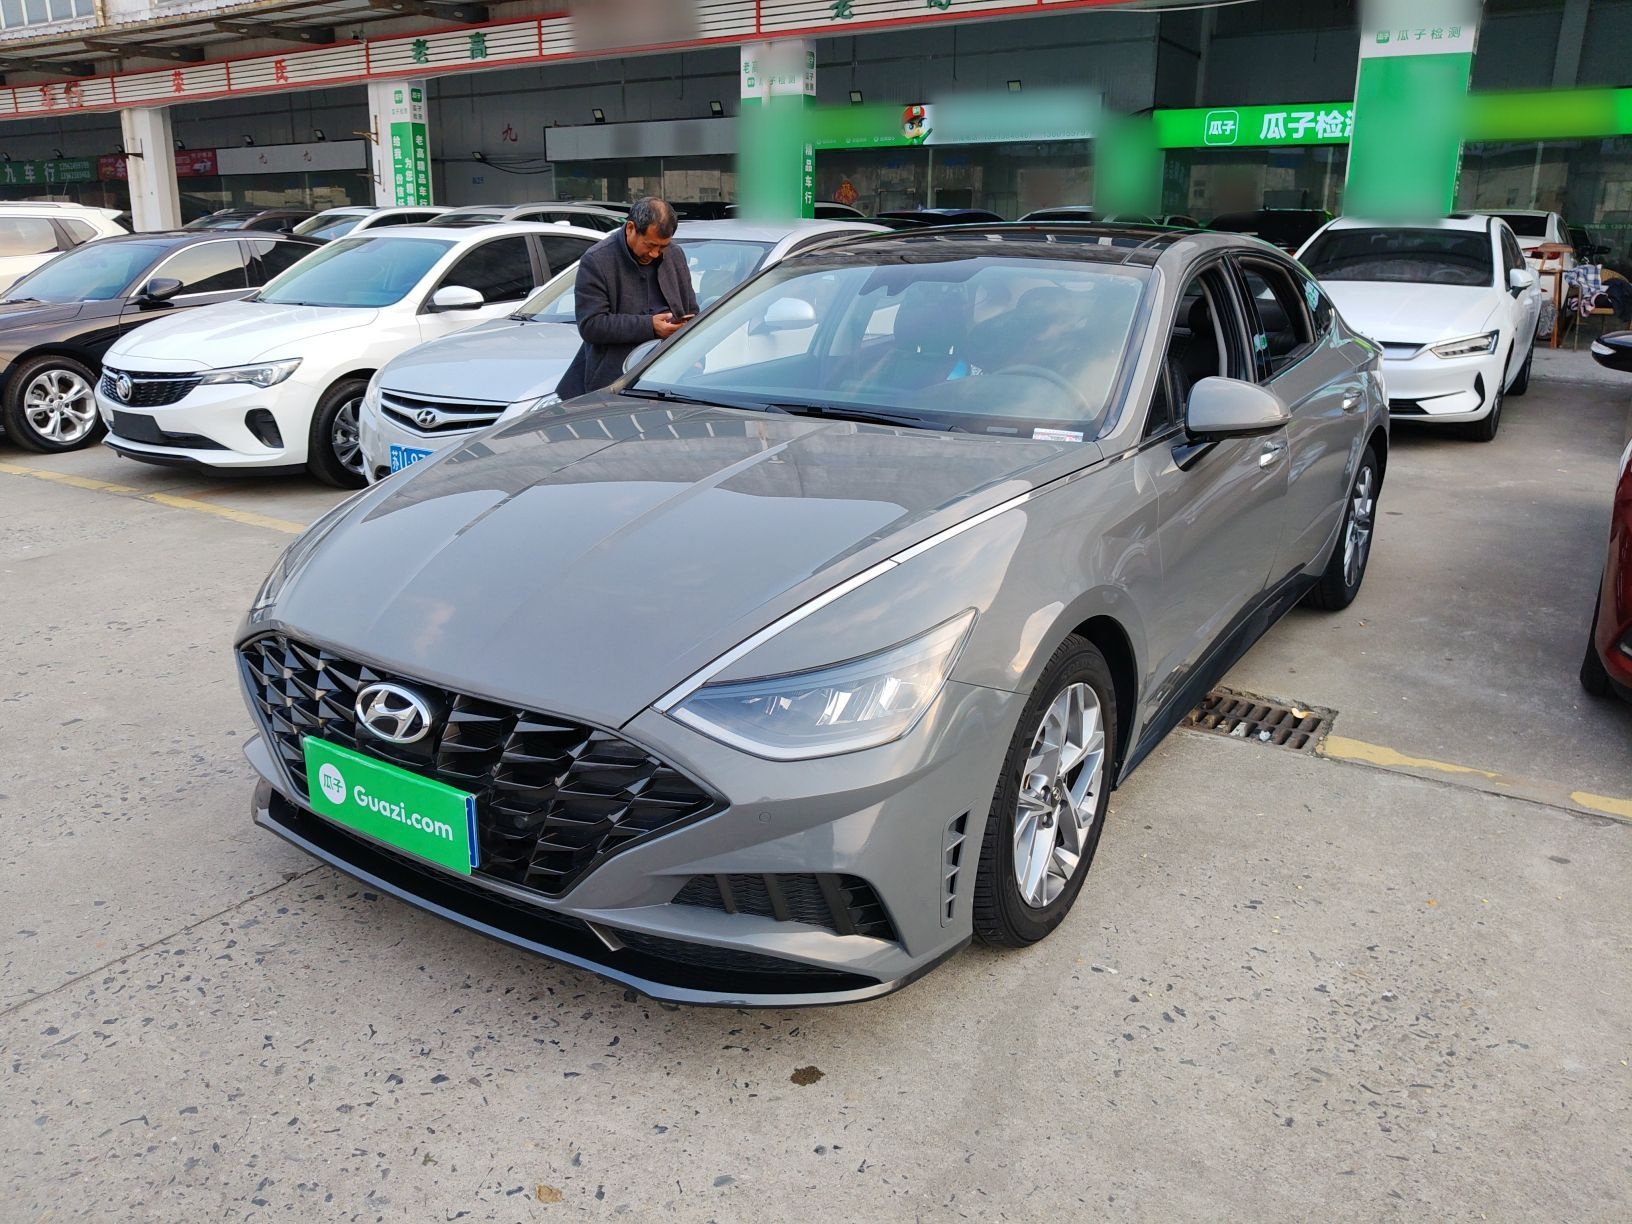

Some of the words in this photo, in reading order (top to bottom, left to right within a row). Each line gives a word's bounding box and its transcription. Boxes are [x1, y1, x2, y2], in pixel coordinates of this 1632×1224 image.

[1396, 26, 1461, 41] 瓜子检测
[412, 32, 487, 64] 老高
[1209, 120, 1235, 136] 瓜子
[1260, 110, 1355, 140] 瓜子检
[323, 773, 343, 793] 瓜子
[353, 785, 453, 841] Guazi.com
